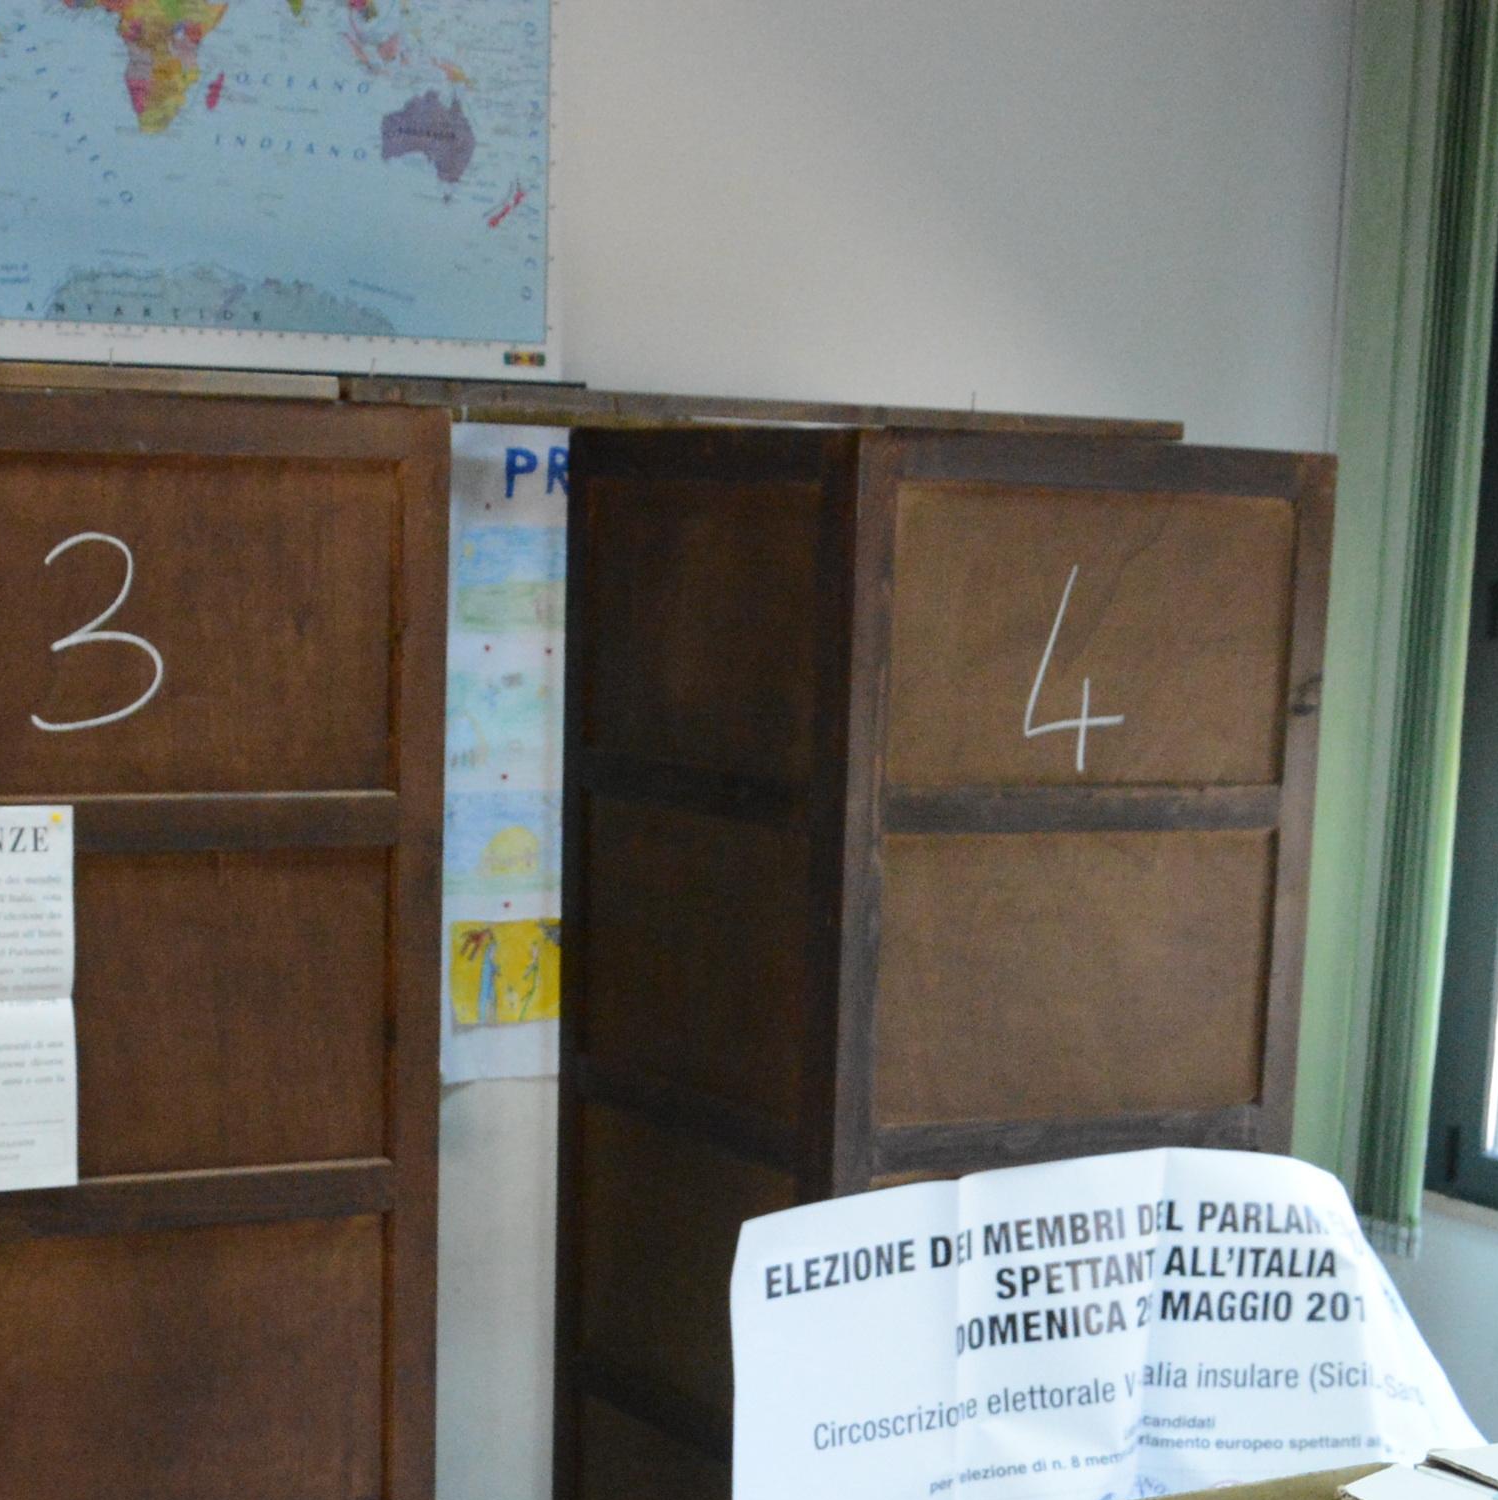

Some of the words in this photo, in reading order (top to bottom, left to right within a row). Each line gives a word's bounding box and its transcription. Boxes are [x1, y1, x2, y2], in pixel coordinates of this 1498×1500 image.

[29, 531, 163, 732] 3
[1024, 564, 1124, 774] 4
[765, 1239, 916, 1299] ELEZIONE
[983, 1207, 1126, 1256] MEMBRI
[995, 1247, 1155, 1300] SPETTANT
[1163, 1245, 1337, 1279] ALL'ITALIA
[956, 1300, 1127, 1356] DOMENICA
[1136, 1294, 1153, 1328] 2
[1160, 1290, 1293, 1323] MAGGIO
[1306, 1292, 1366, 1323] 201
[987, 1376, 1116, 1416] elettorale
[1143, 1361, 1188, 1389] alia
[1196, 1363, 1299, 1389] insulare
[1032, 1457, 1048, 1473] di
[1214, 1436, 1284, 1452] europeo
[1289, 1433, 1362, 1452] spettanti
[1142, 1415, 1216, 1431] candidati
